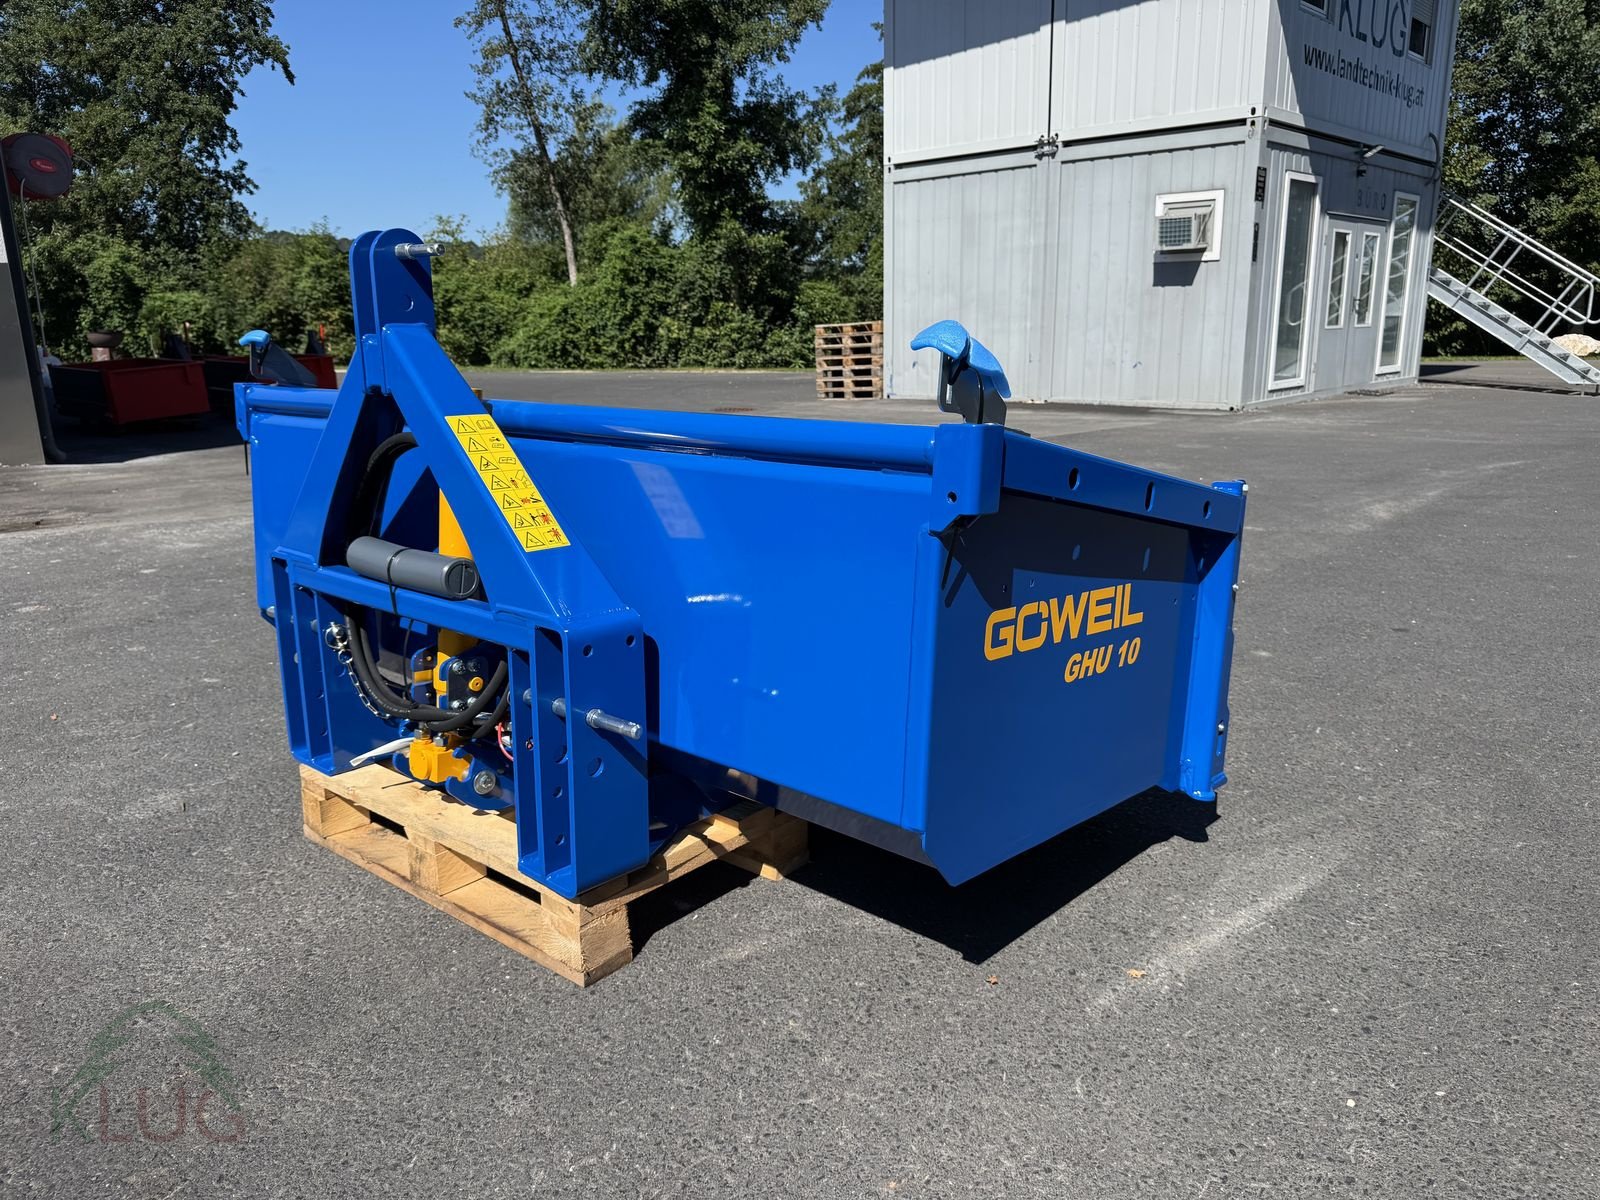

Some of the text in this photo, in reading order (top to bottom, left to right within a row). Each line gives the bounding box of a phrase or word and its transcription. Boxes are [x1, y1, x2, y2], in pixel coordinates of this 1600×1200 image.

[1338, 0, 1408, 57] KLUG
[1304, 44, 1424, 108] www.landtechnik-klug.at
[1064, 637, 1141, 683] GHU 10
